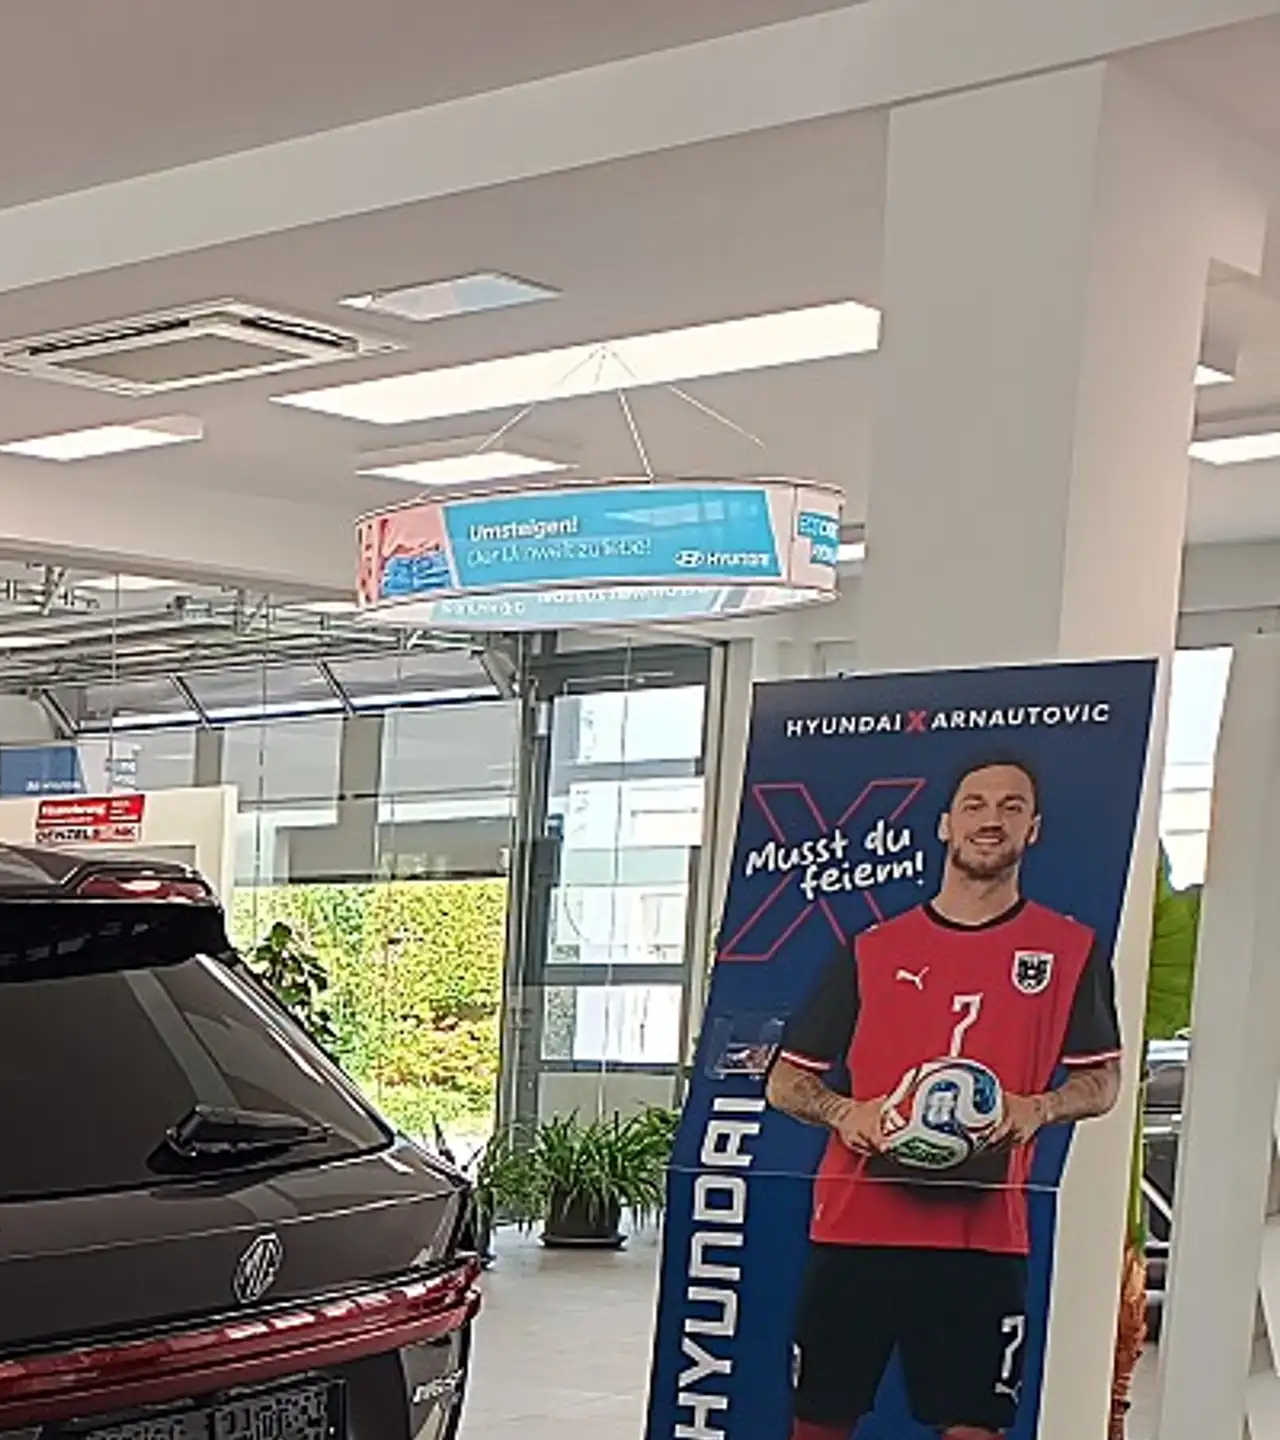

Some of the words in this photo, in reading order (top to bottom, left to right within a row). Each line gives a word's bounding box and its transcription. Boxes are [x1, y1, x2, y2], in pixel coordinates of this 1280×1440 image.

[469, 515, 578, 542] Umsteigen!
[786, 713, 902, 738] HYUNDAI
[905, 710, 928, 733] X
[930, 703, 1111, 730] ARNAUTOVIC
[744, 829, 849, 877] Musst
[864, 819, 911, 856] du
[800, 850, 924, 900] feiern!
[951, 992, 984, 1057] 7
[1001, 1315, 1025, 1380] 7
